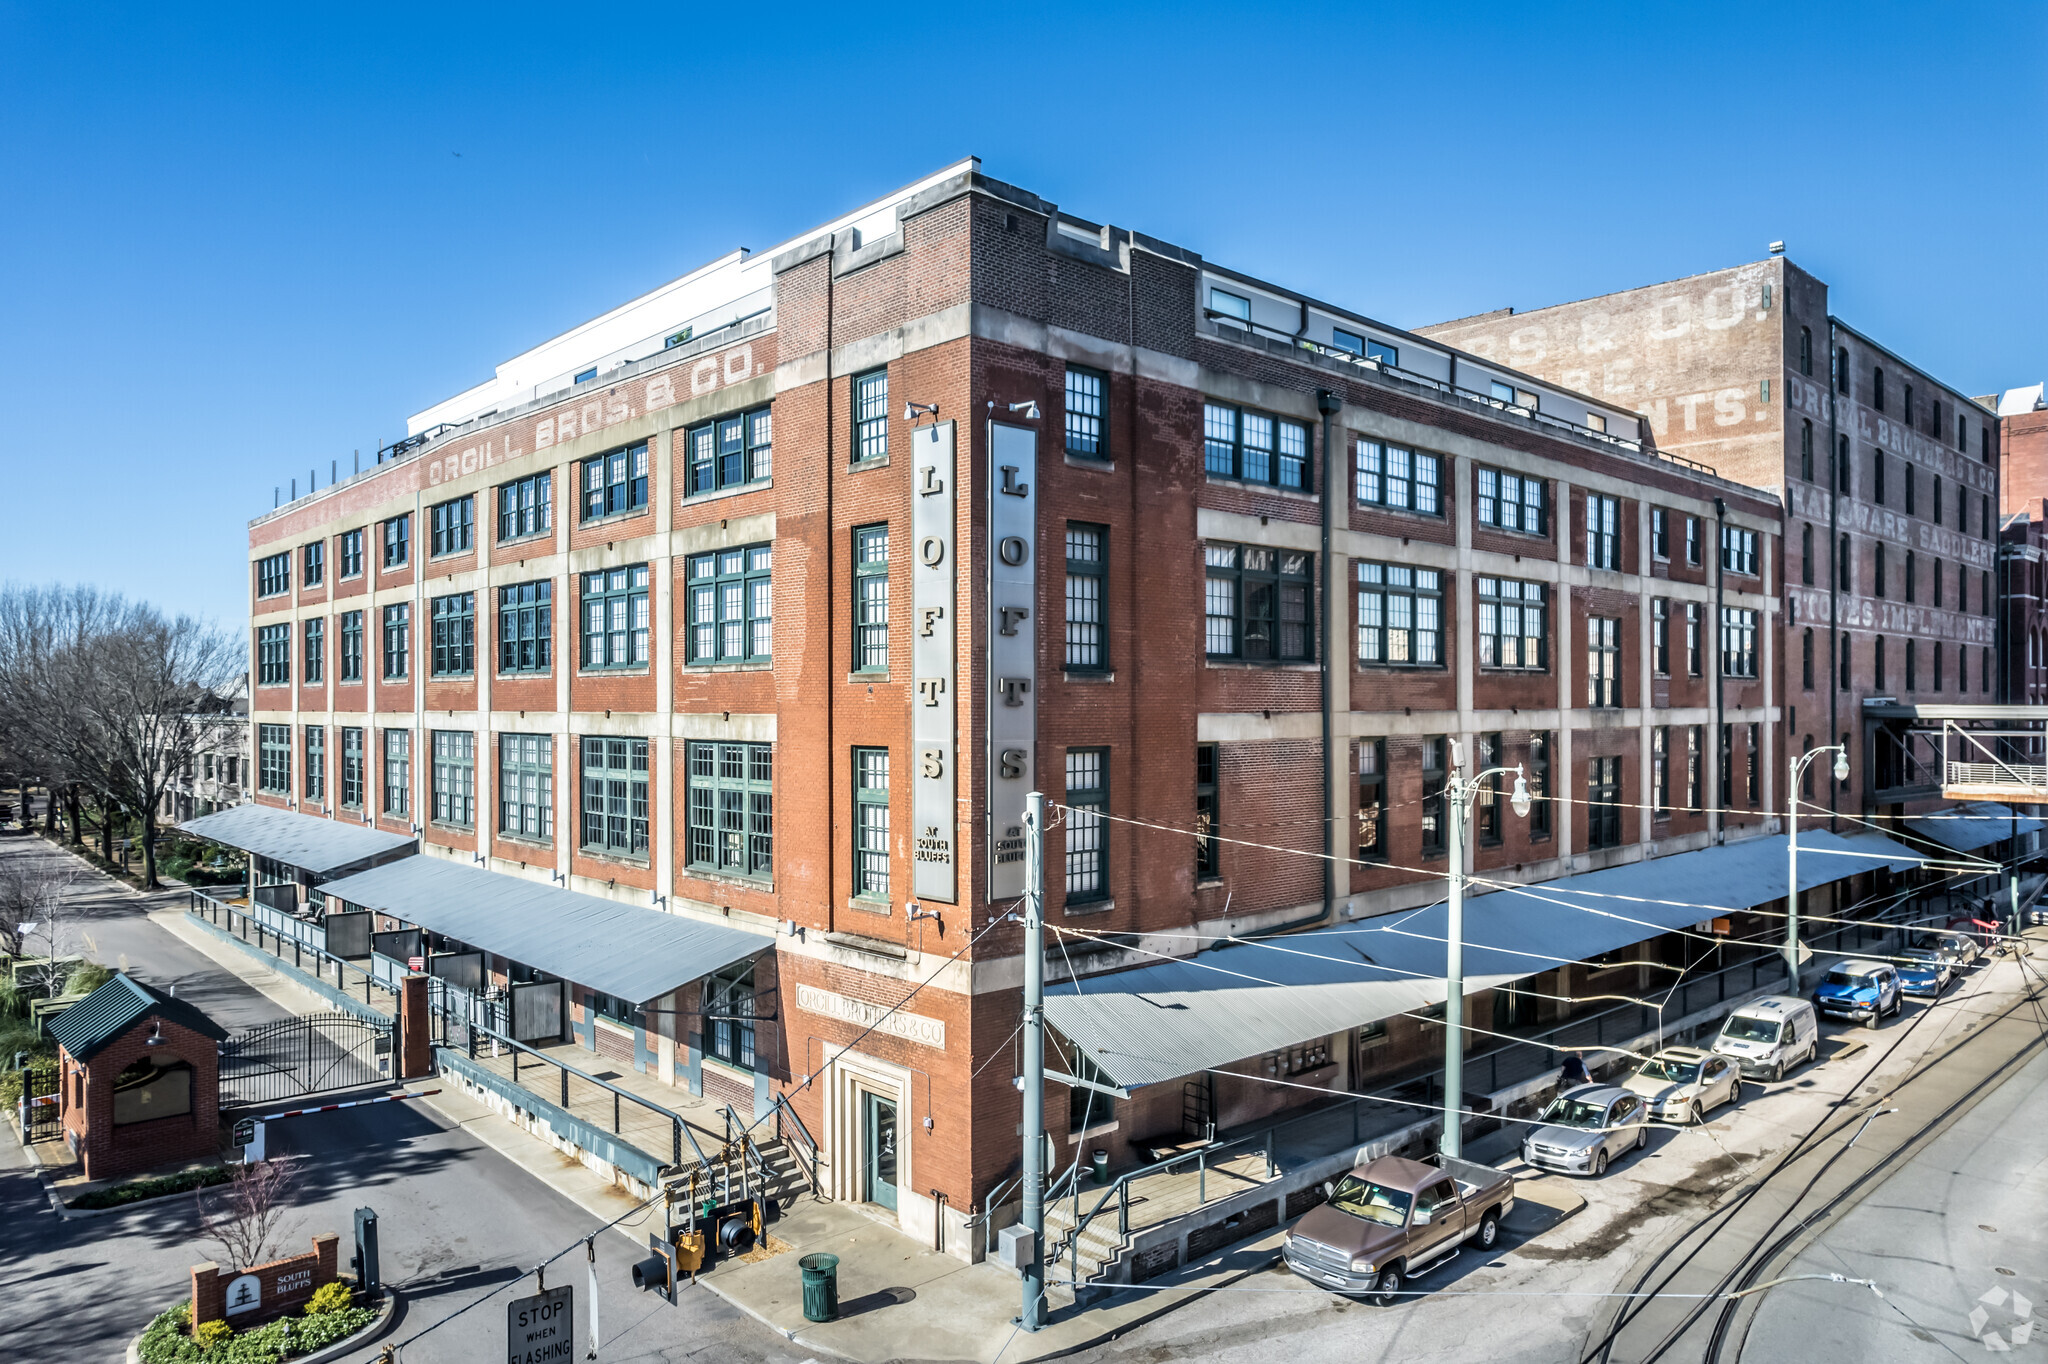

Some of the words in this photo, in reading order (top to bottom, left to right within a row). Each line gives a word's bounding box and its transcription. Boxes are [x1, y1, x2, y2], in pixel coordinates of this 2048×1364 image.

[429, 435, 522, 485] ORGILL
[535, 399, 637, 448] BROS.
[646, 374, 676, 410] &
[691, 343, 764, 396] CO.
[918, 464, 946, 781] LOFTS
[1001, 464, 1031, 780] LOFTS
[925, 826, 939, 838] AT
[1006, 826, 1022, 837] AT
[917, 838, 949, 851] SOUTH
[996, 838, 1026, 851] SOUT
[914, 850, 950, 864] BLUFFS
[994, 851, 1025, 864] BLUF
[800, 989, 841, 1016] ORGILL
[843, 1000, 906, 1033] BROTHERS
[909, 1019, 917, 1037] &
[921, 1022, 942, 1043] CO
[277, 1269, 310, 1285] SOUTH
[277, 1278, 312, 1294] BLUFFS
[518, 1301, 563, 1327] STOP
[526, 1326, 556, 1343] WHEN
[511, 1339, 570, 1364] FLASHING
